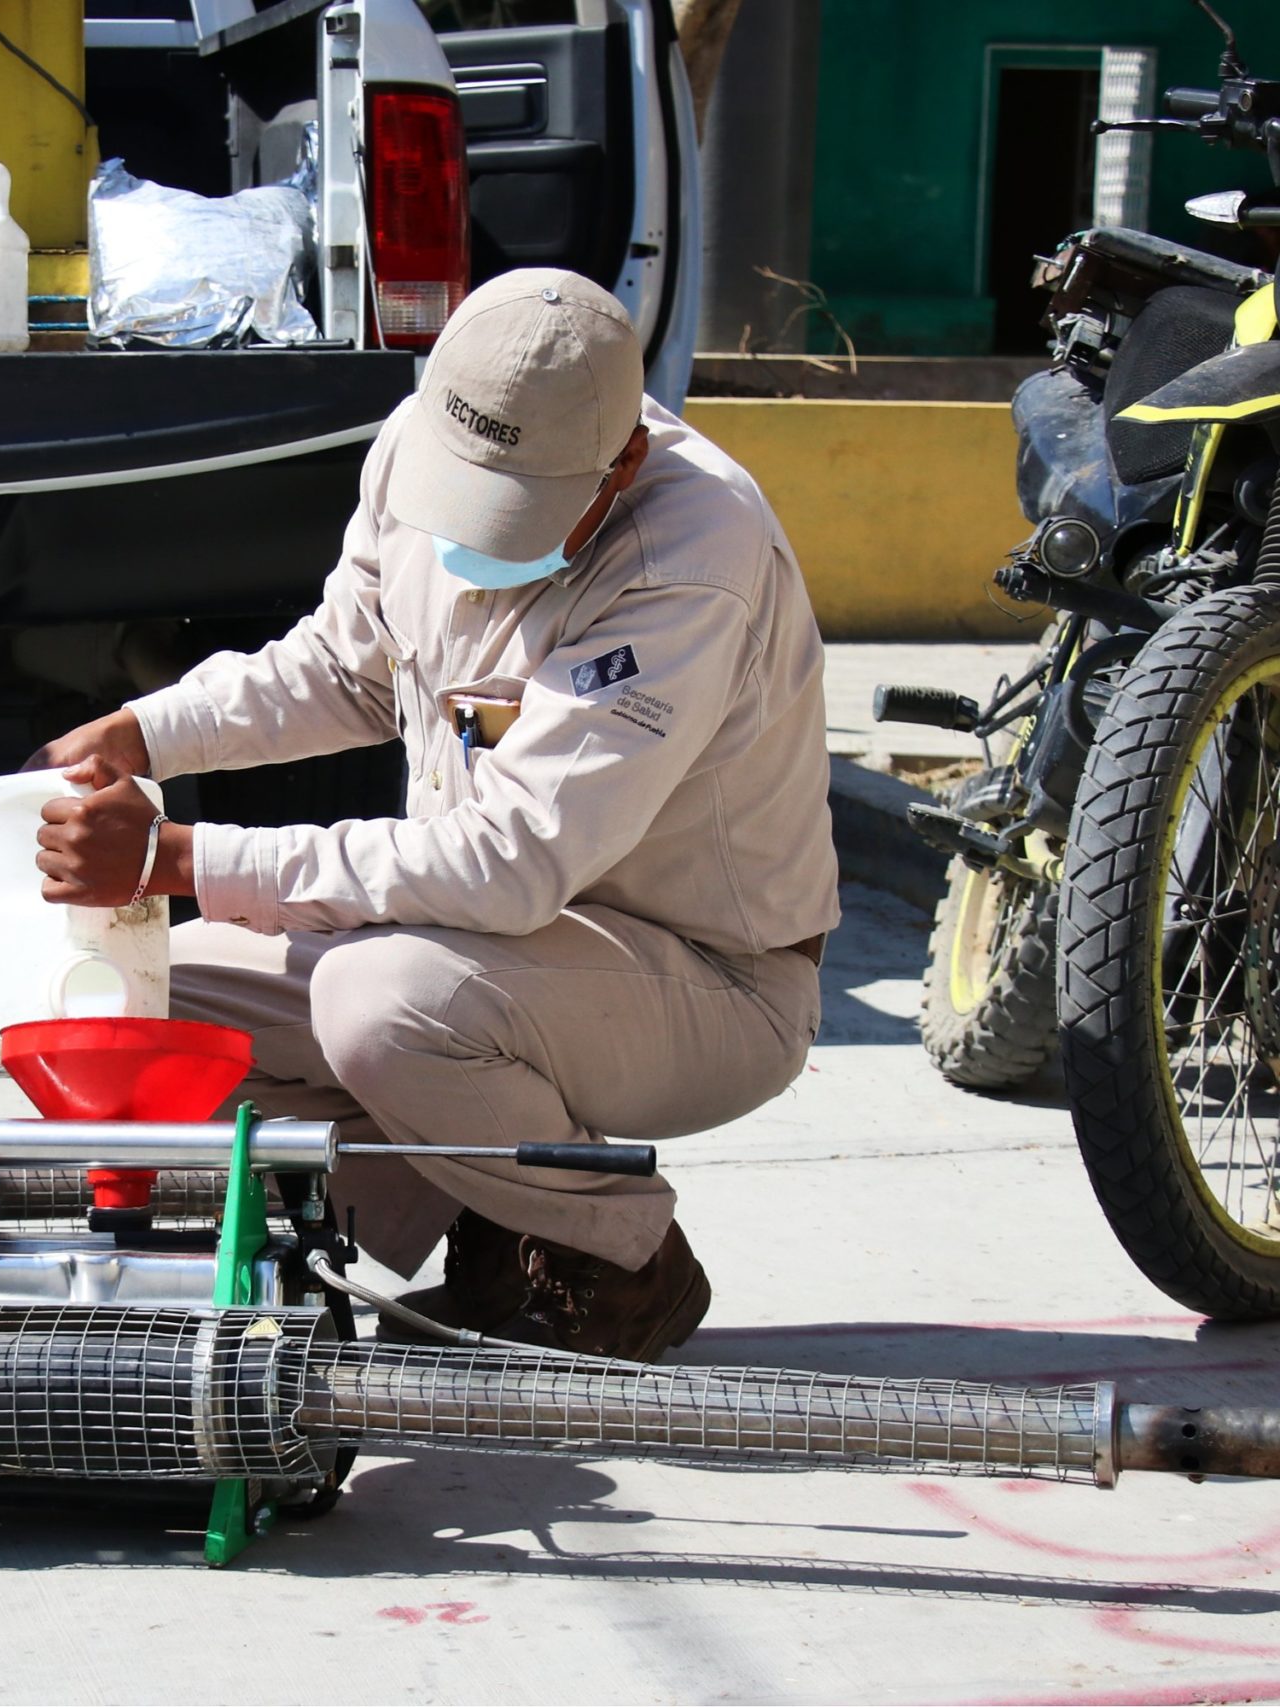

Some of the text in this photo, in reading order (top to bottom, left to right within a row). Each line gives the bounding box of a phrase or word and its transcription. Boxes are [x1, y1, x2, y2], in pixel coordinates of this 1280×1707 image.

[445, 388, 522, 446] VECTORES
[617, 697, 661, 722] de Salud
[622, 685, 674, 715] Secretaría
